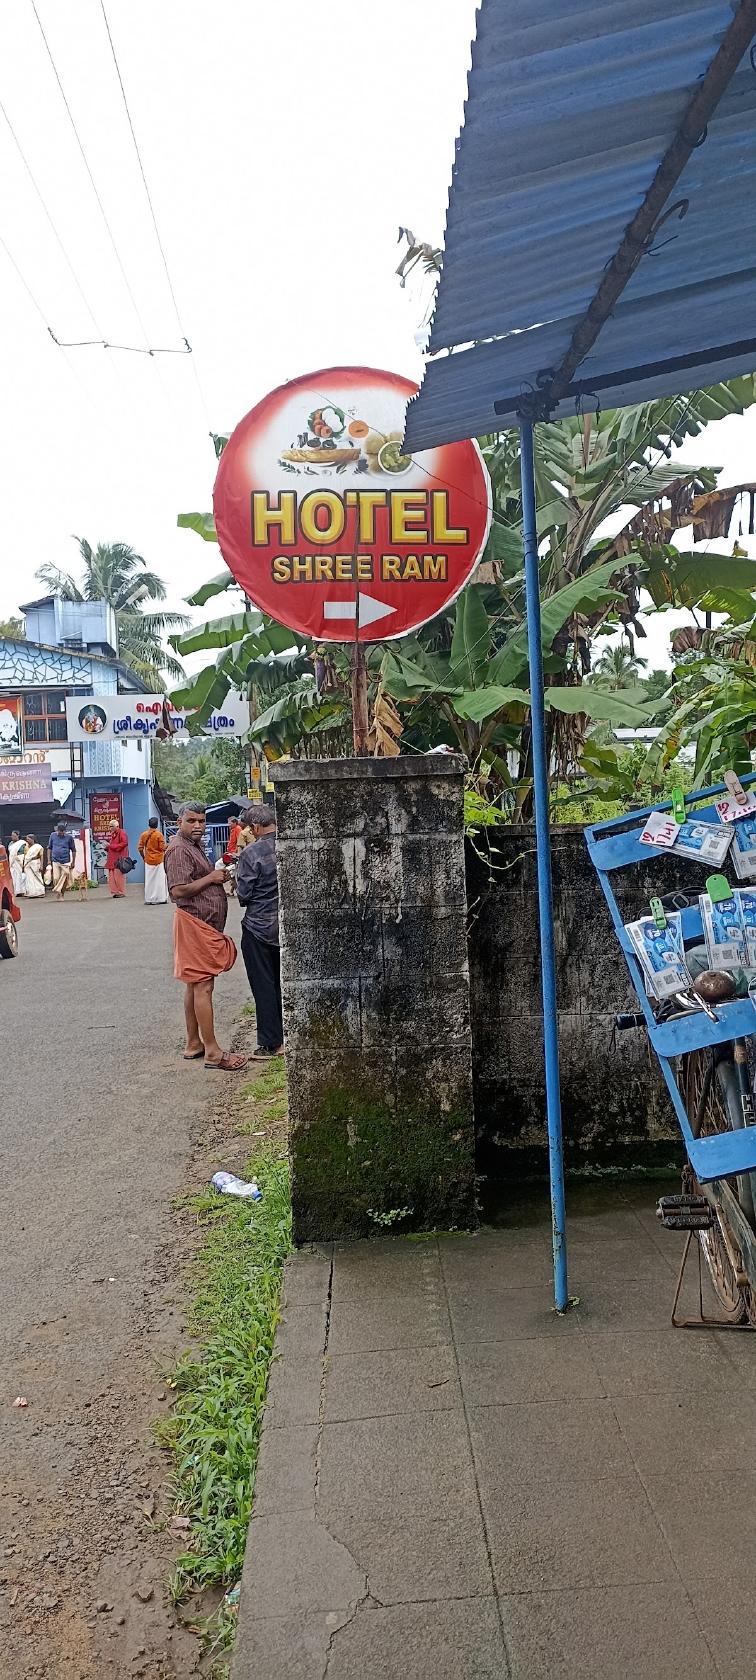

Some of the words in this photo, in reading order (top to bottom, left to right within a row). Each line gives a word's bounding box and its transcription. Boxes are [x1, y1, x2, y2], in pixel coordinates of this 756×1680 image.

[252, 490, 468, 545] HOTEL
[272, 555, 373, 583] SHREE
[381, 555, 448, 583] RAM
[2, 779, 47, 791] KRISHNA
